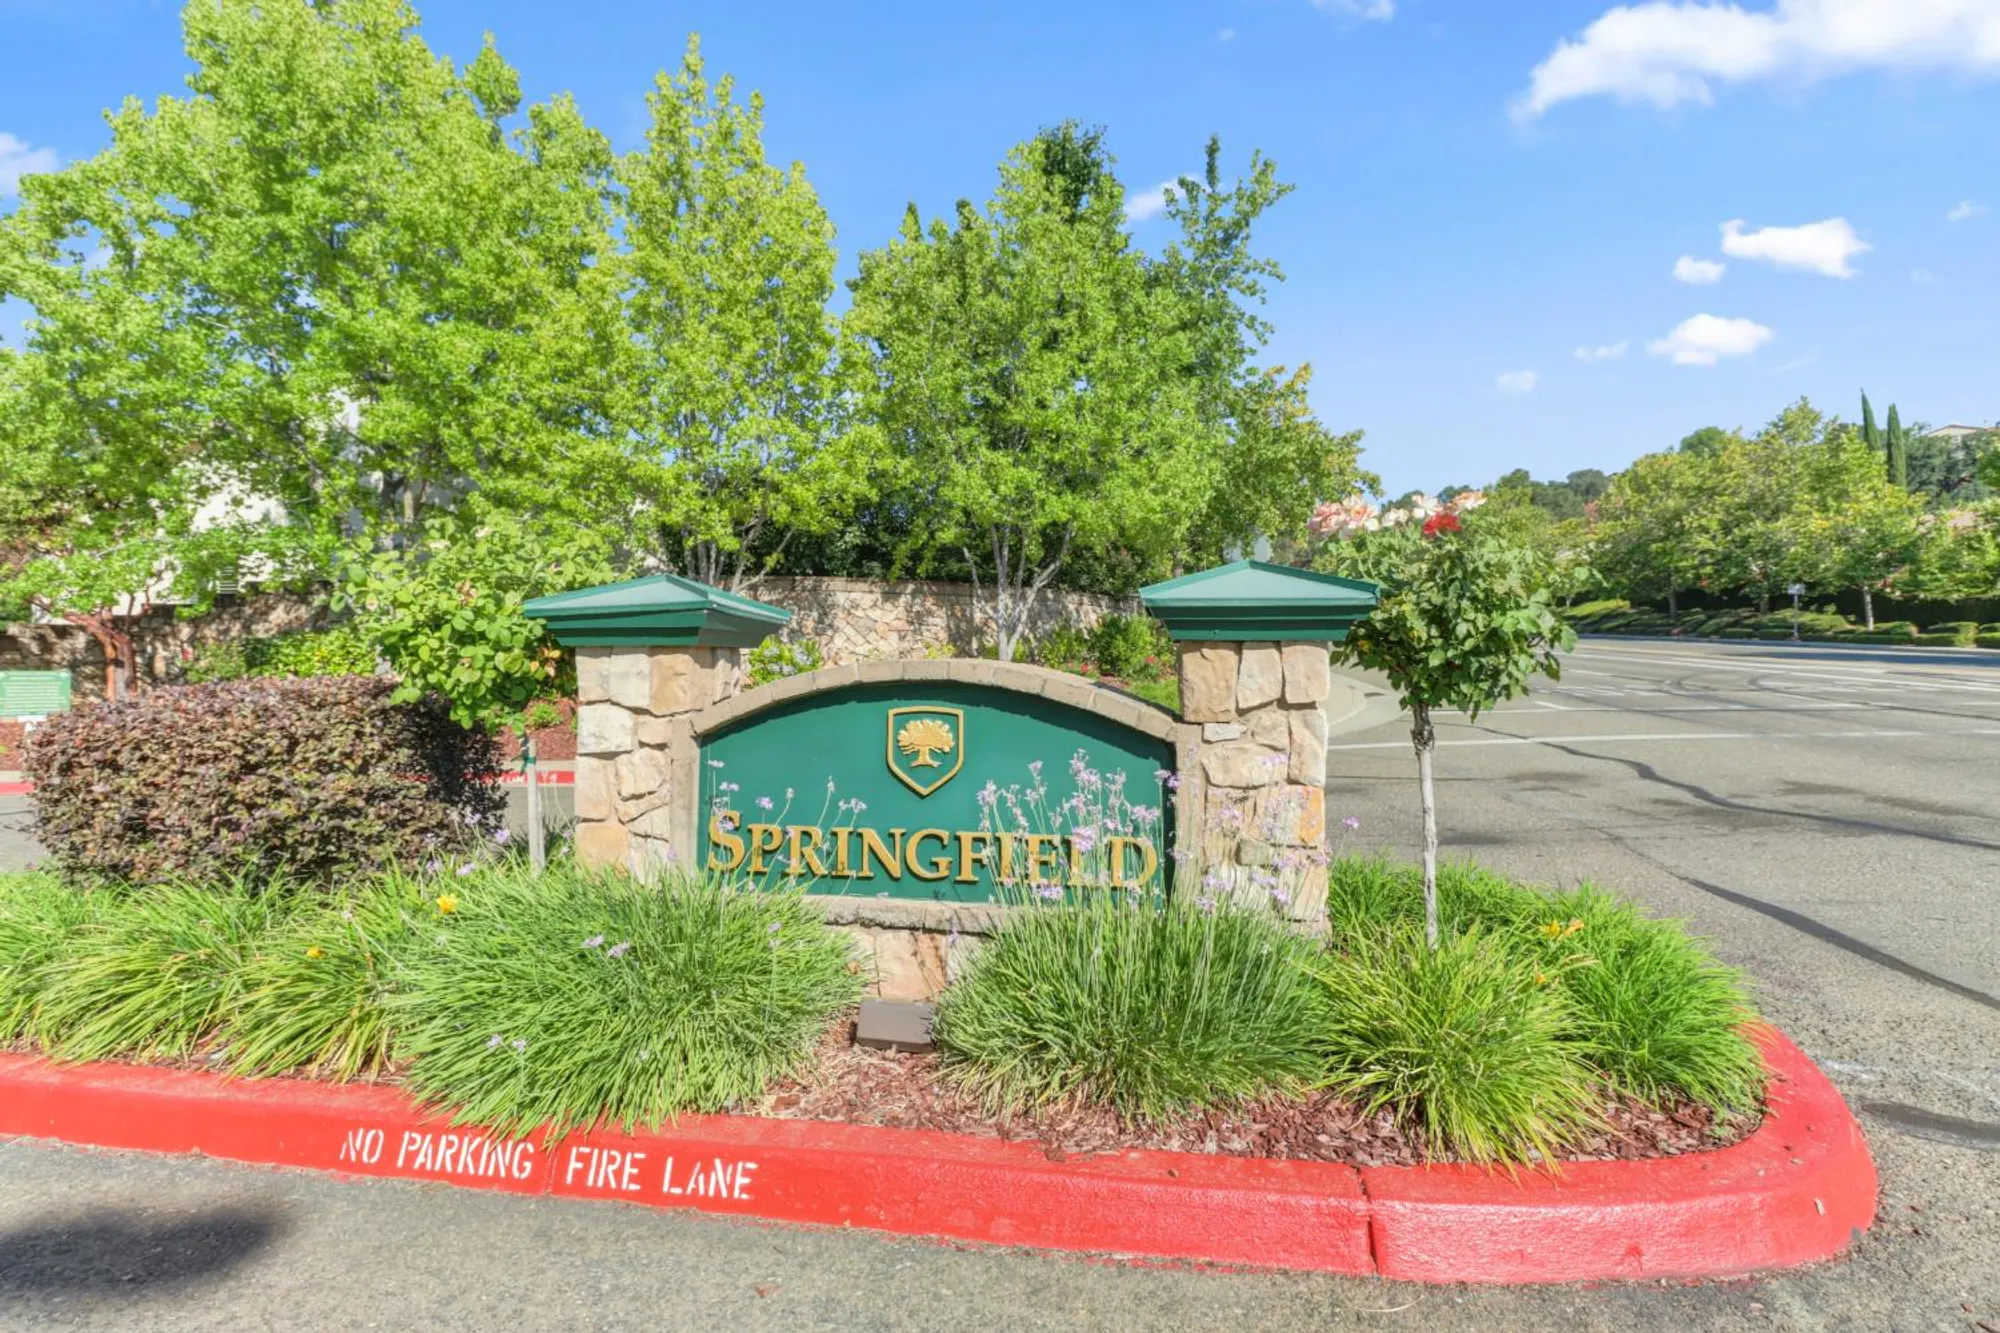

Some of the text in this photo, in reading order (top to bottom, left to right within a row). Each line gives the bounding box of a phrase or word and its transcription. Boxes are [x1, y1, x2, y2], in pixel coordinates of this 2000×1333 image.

[707, 810, 1159, 888] SPRINGFIELD
[339, 1128, 759, 1200] NO PARKING FIRE LANE
